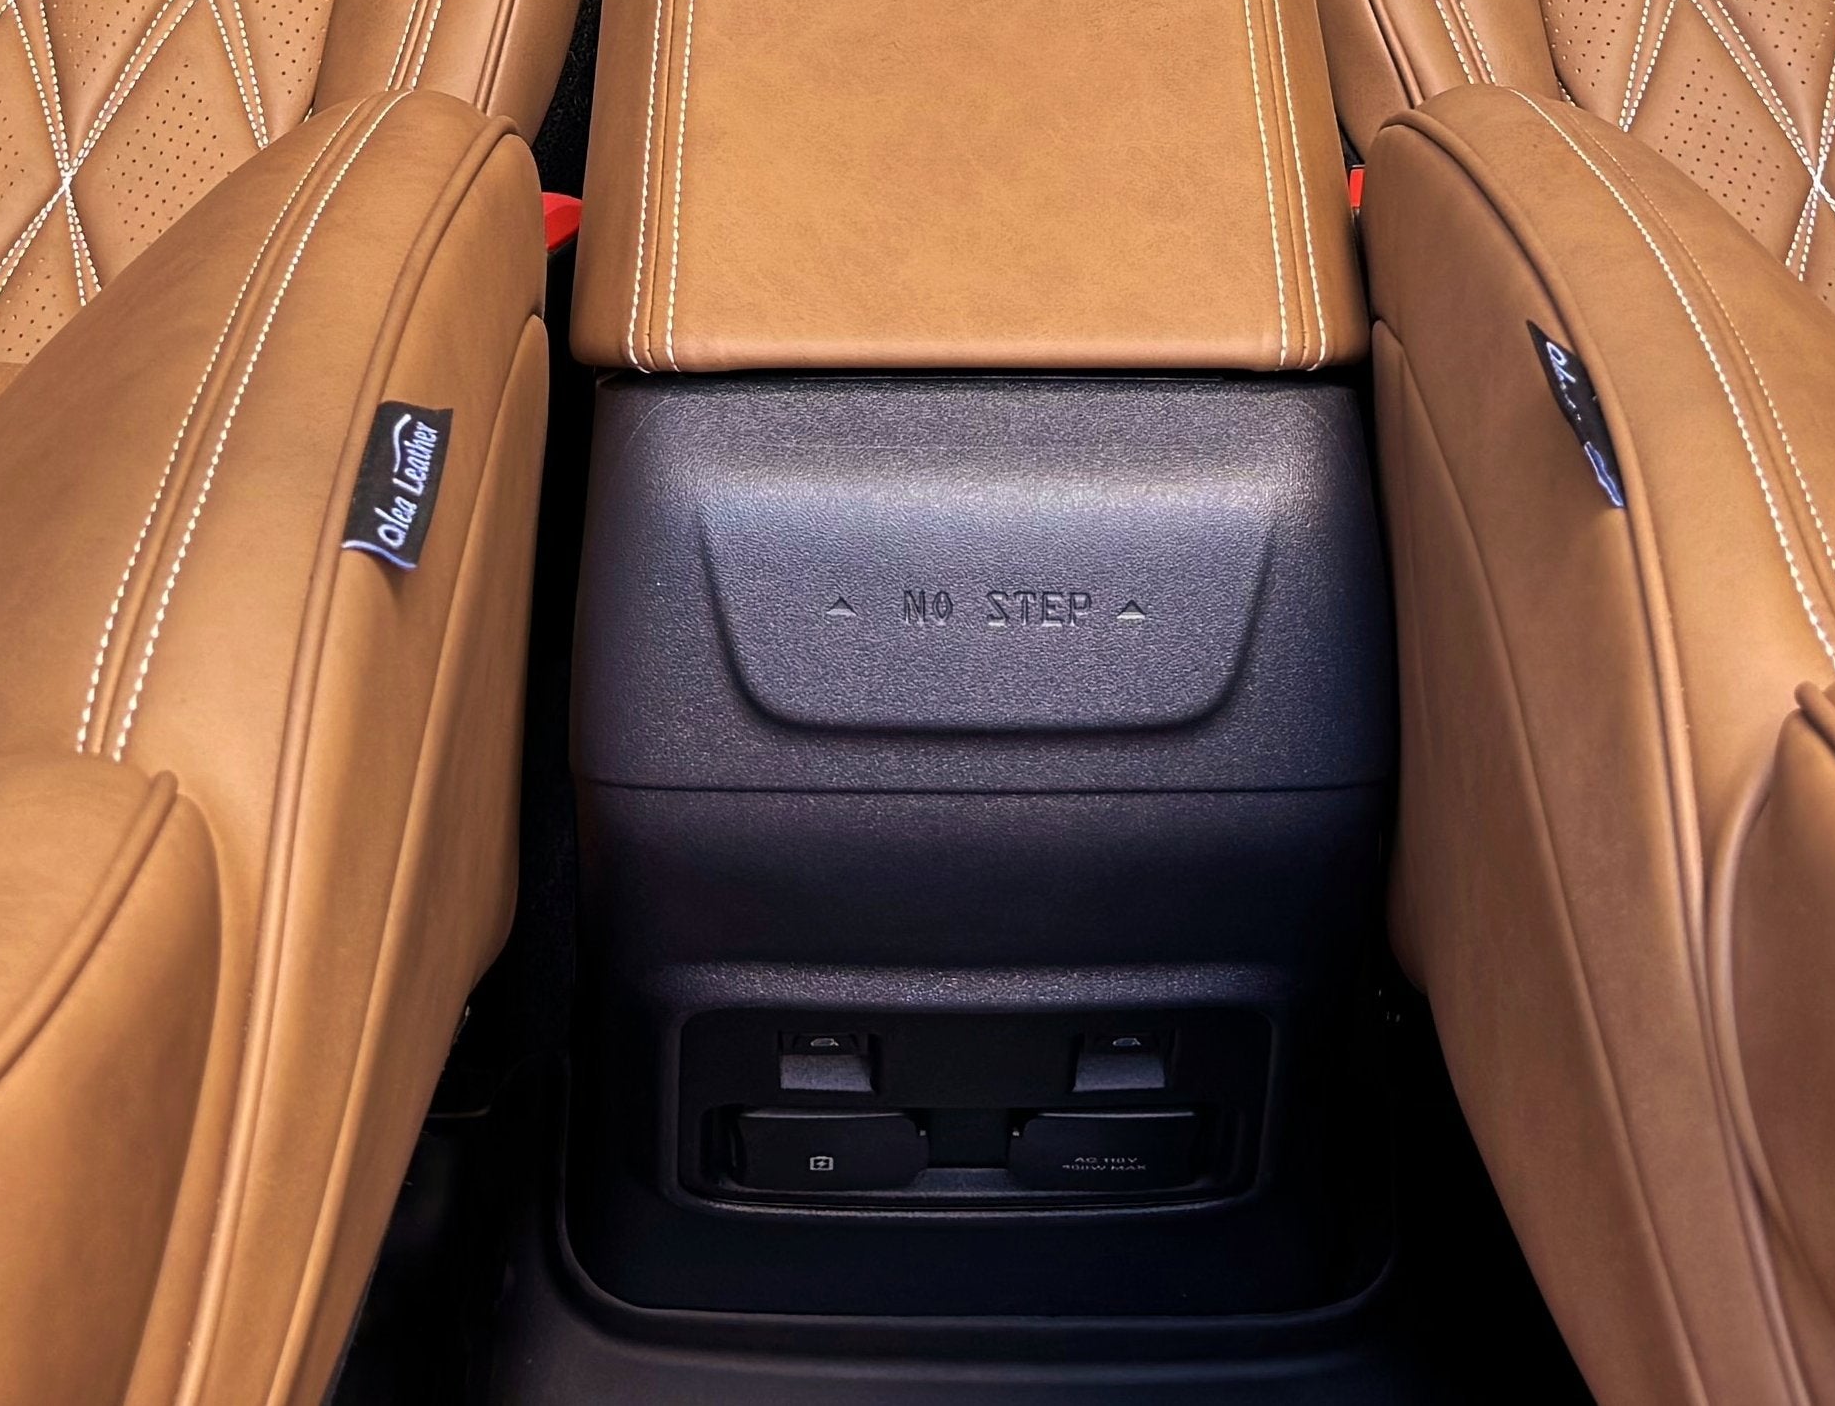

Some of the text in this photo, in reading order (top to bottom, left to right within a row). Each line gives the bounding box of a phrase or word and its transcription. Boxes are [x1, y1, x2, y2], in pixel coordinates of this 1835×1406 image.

[392, 420, 439, 497] Leather
[903, 589, 1093, 628] NO STEP
